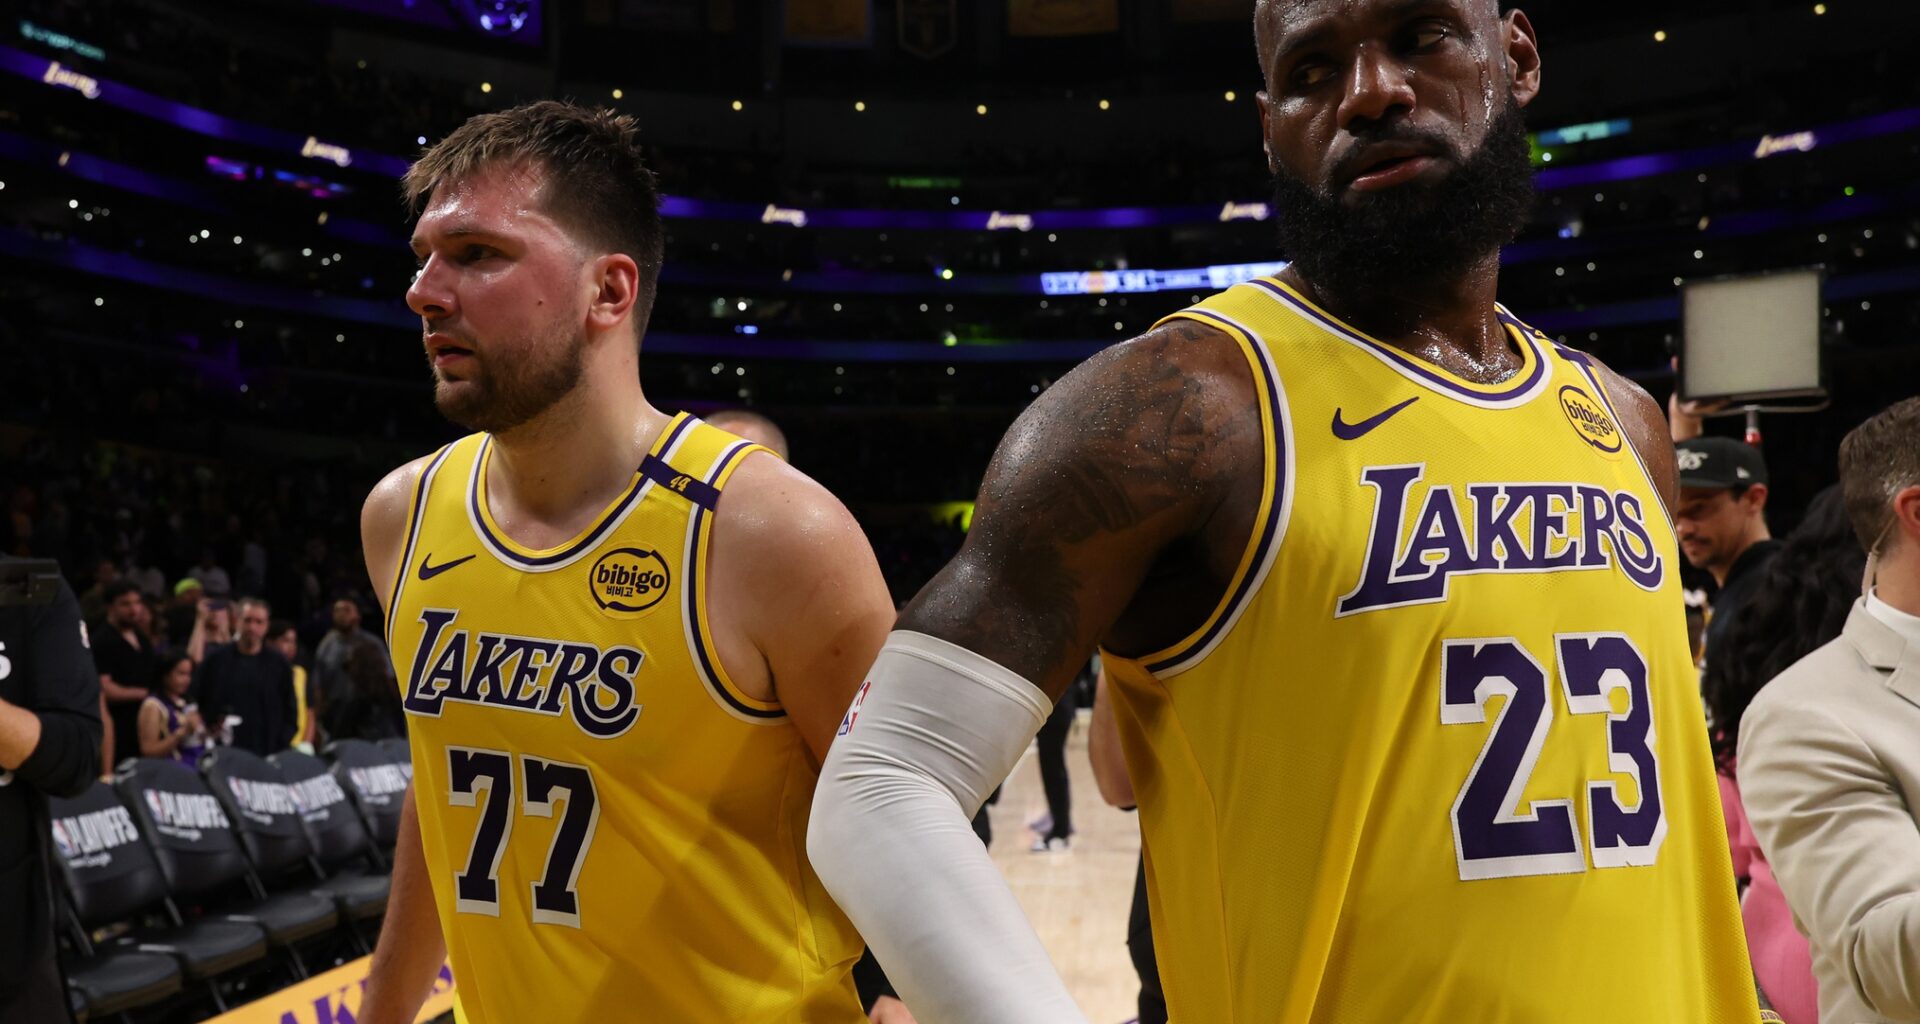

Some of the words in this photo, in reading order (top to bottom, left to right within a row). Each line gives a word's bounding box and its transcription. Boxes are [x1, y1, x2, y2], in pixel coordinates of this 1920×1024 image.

[1564, 399, 1613, 436] bibigo
[669, 475, 692, 492] 44
[1333, 462, 1665, 619] LAKERS
[597, 563, 665, 594] bibigo
[606, 585, 633, 598] 비비고
[402, 607, 646, 740] LAKERS
[1440, 631, 1669, 881] 23
[62, 805, 139, 856] PLAYOFFS
[445, 745, 600, 929] 77
